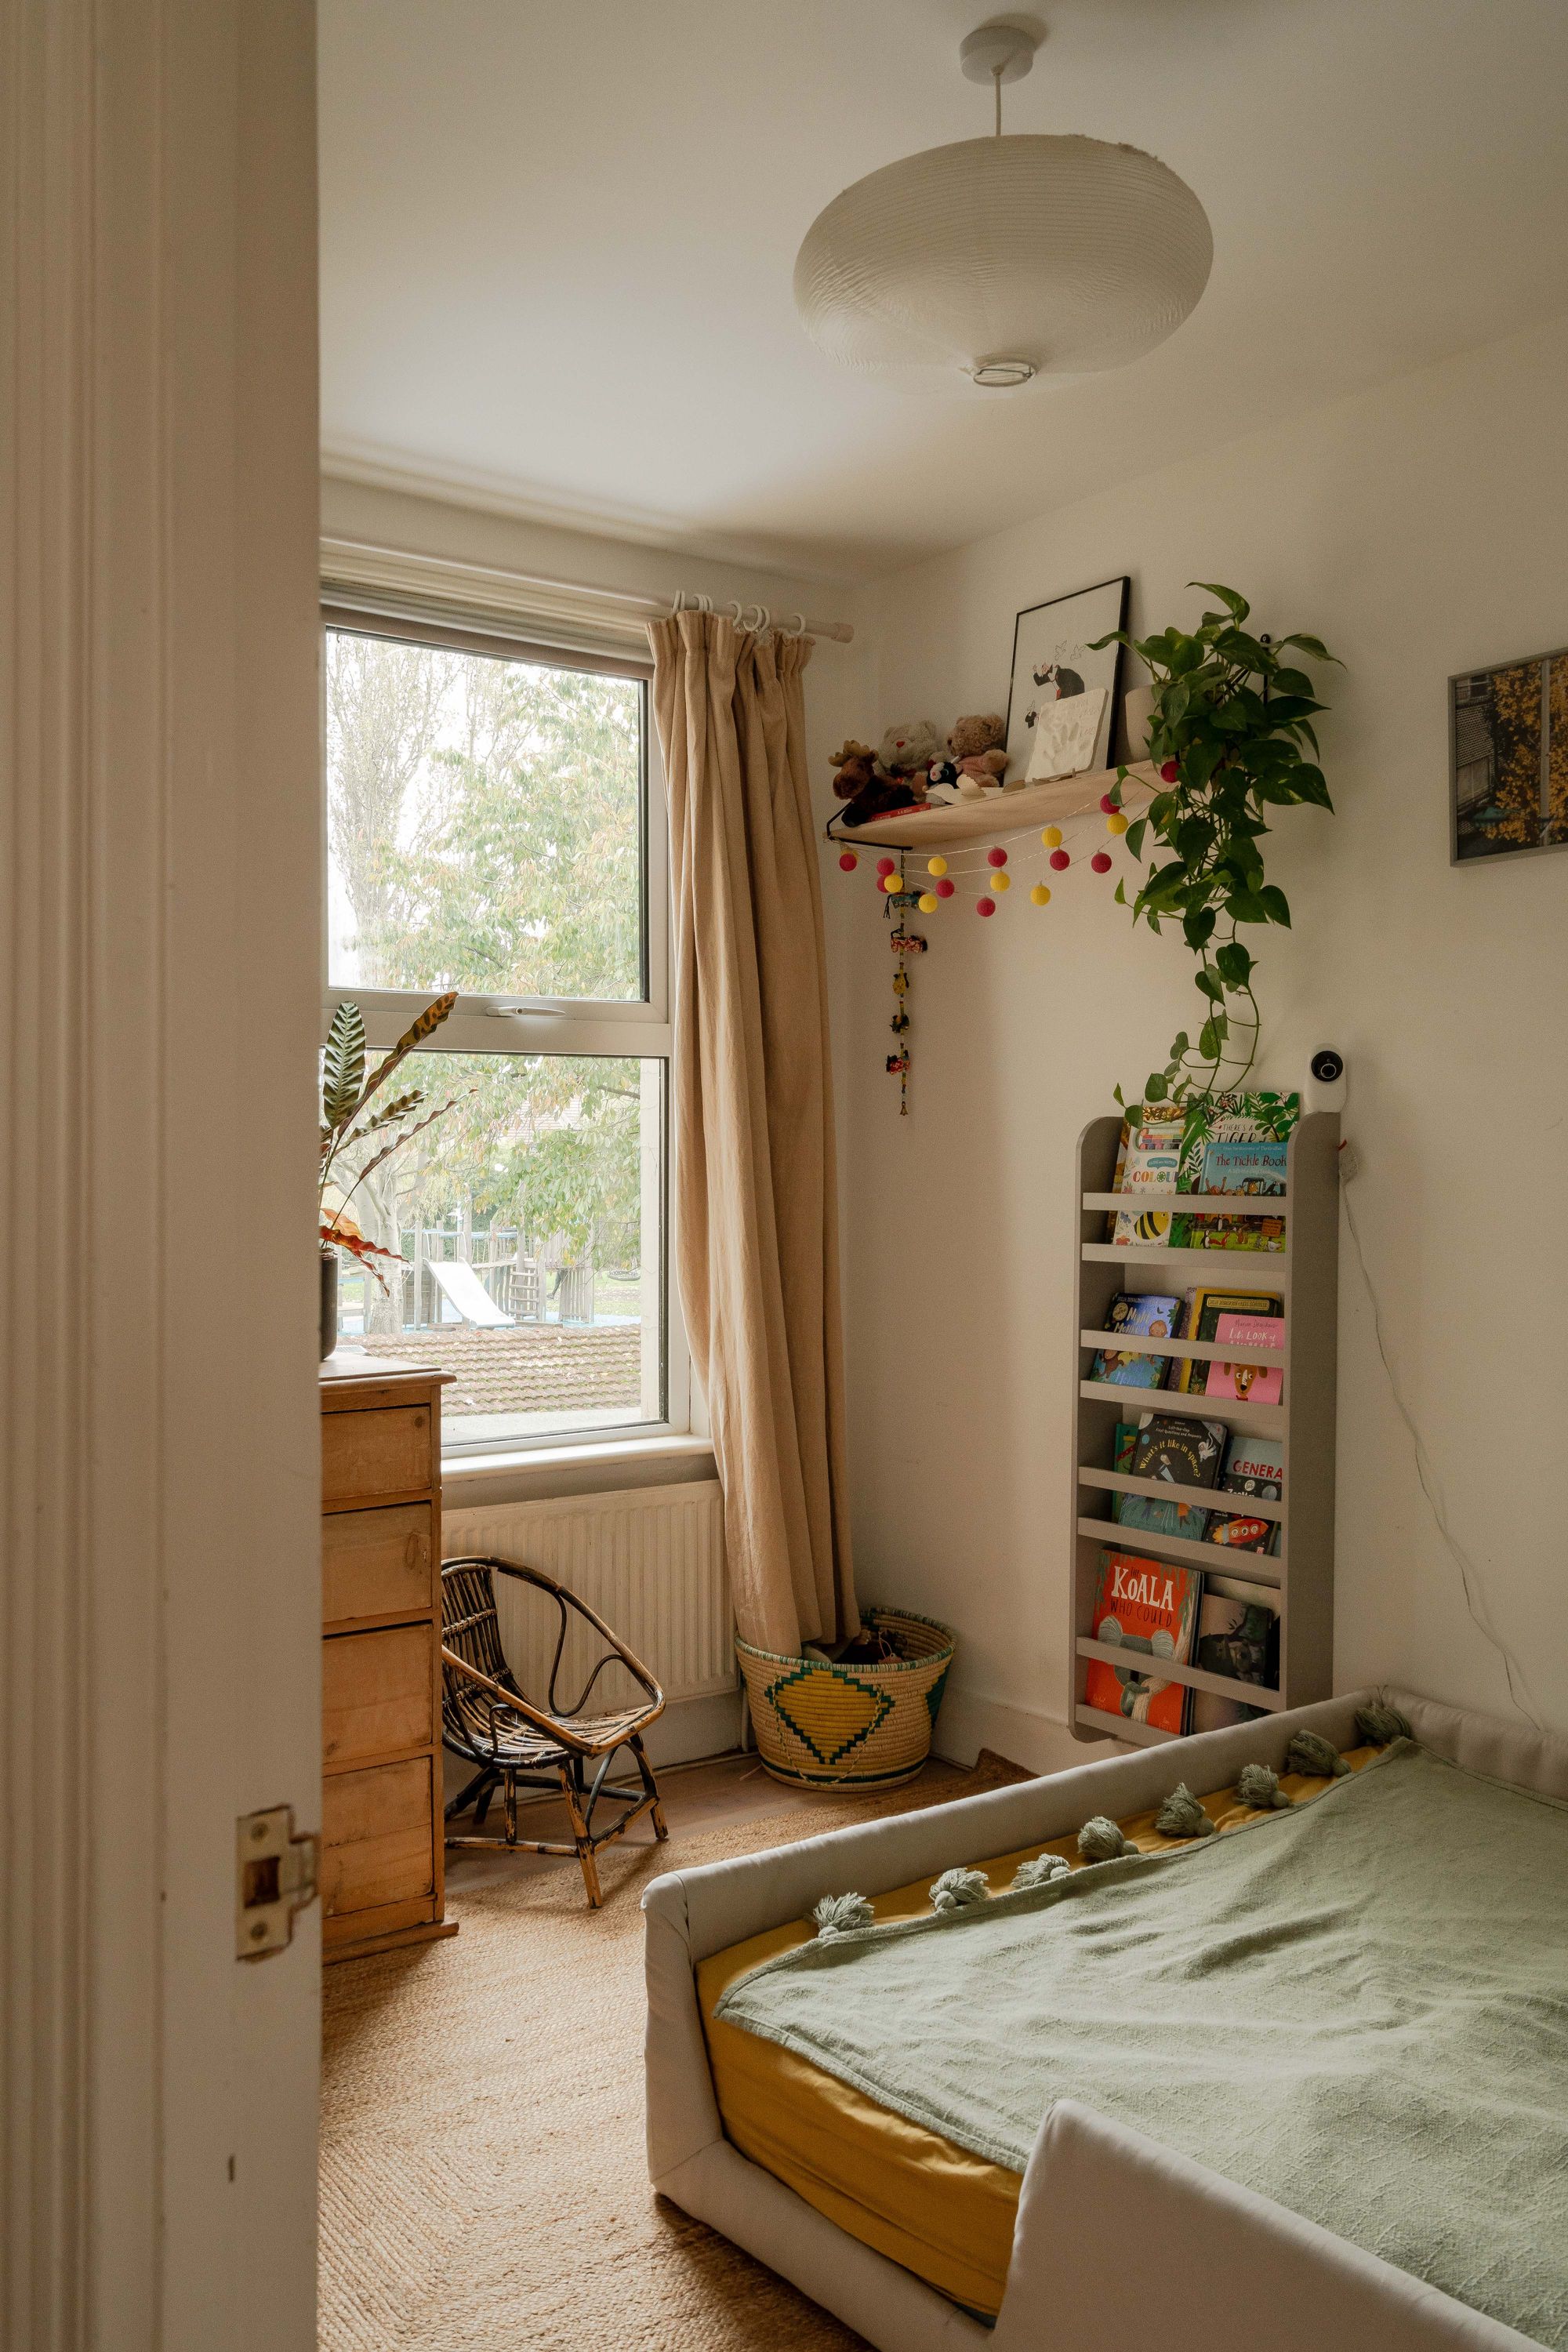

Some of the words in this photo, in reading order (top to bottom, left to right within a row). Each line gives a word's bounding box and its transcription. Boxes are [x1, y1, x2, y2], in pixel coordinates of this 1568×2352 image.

[1214, 1131, 1257, 1142] TIGER
[1216, 1153, 1231, 1166] The
[1233, 1153, 1259, 1167] Tickle
[1261, 1155, 1287, 1167] Book
[1246, 1331, 1268, 1341] LOOK
[1139, 1445, 1158, 1469] What's
[1160, 1440, 1165, 1449] it
[1167, 1439, 1180, 1449] like
[1181, 1443, 1188, 1453] in
[1188, 1450, 1201, 1477] space?
[1232, 1460, 1283, 1480] GENERA
[1110, 1598, 1133, 1617] WHO
[1136, 1605, 1172, 1628] COULD
